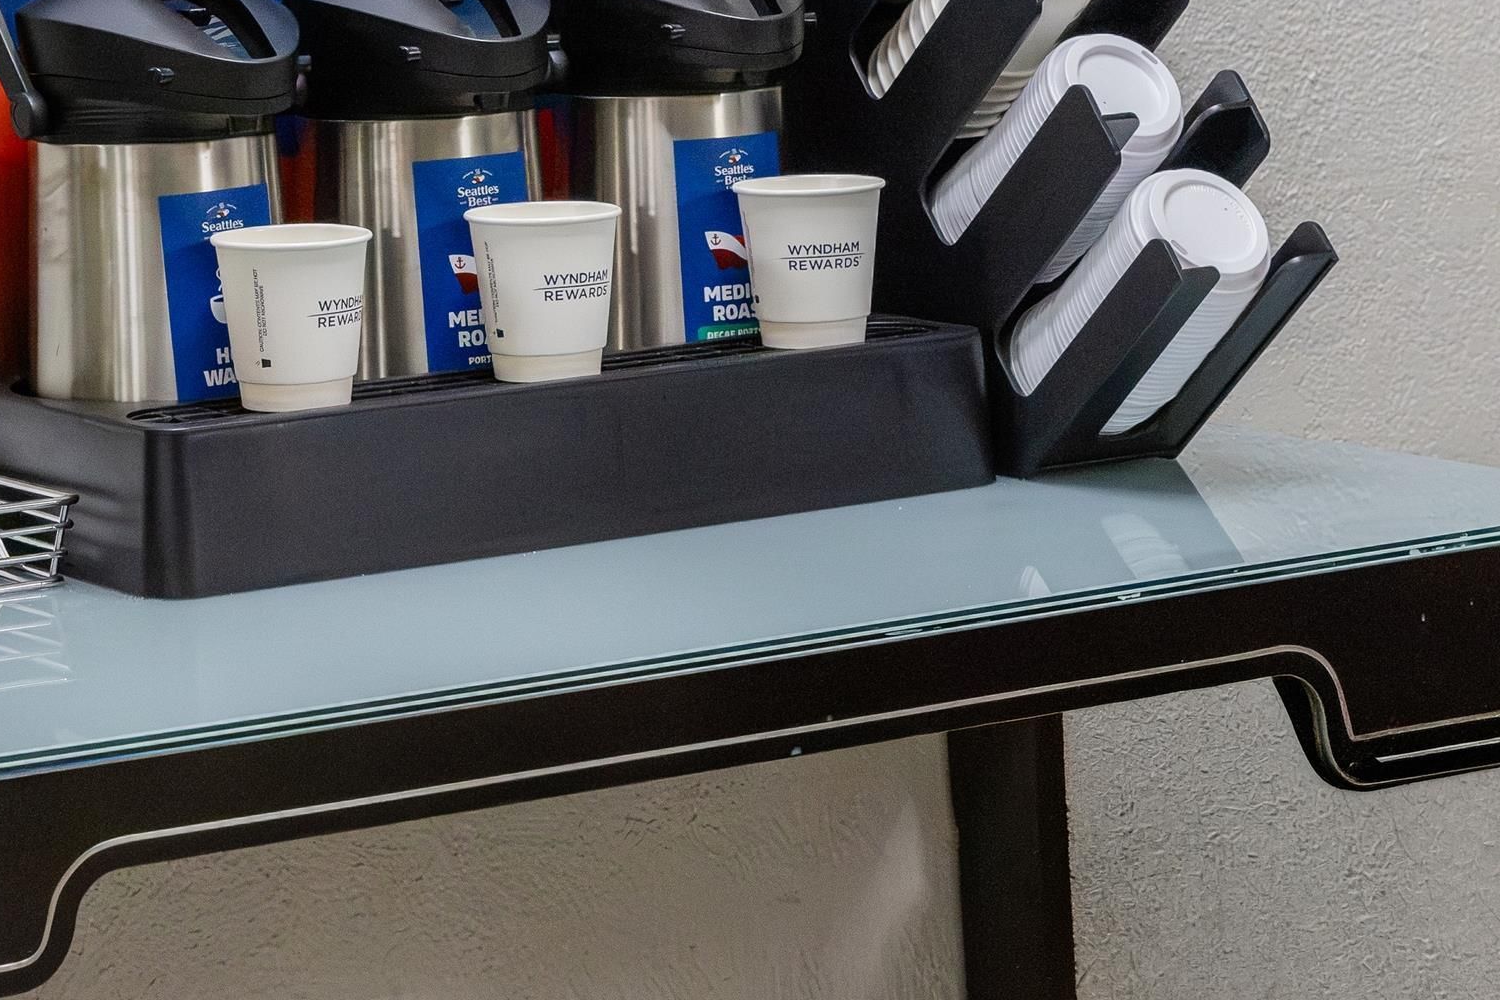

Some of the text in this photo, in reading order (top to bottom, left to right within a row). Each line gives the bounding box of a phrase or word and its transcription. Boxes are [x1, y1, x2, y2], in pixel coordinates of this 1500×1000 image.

[457, 184, 499, 198] Seattle's
[468, 196, 492, 207] Best
[202, 219, 244, 233] Seattle's
[787, 240, 860, 256] WYNDHAM
[543, 268, 608, 286] WYNDHAM
[544, 285, 608, 302] REWARDS
[703, 282, 751, 302] MEDI
[468, 354, 492, 365] PORT
